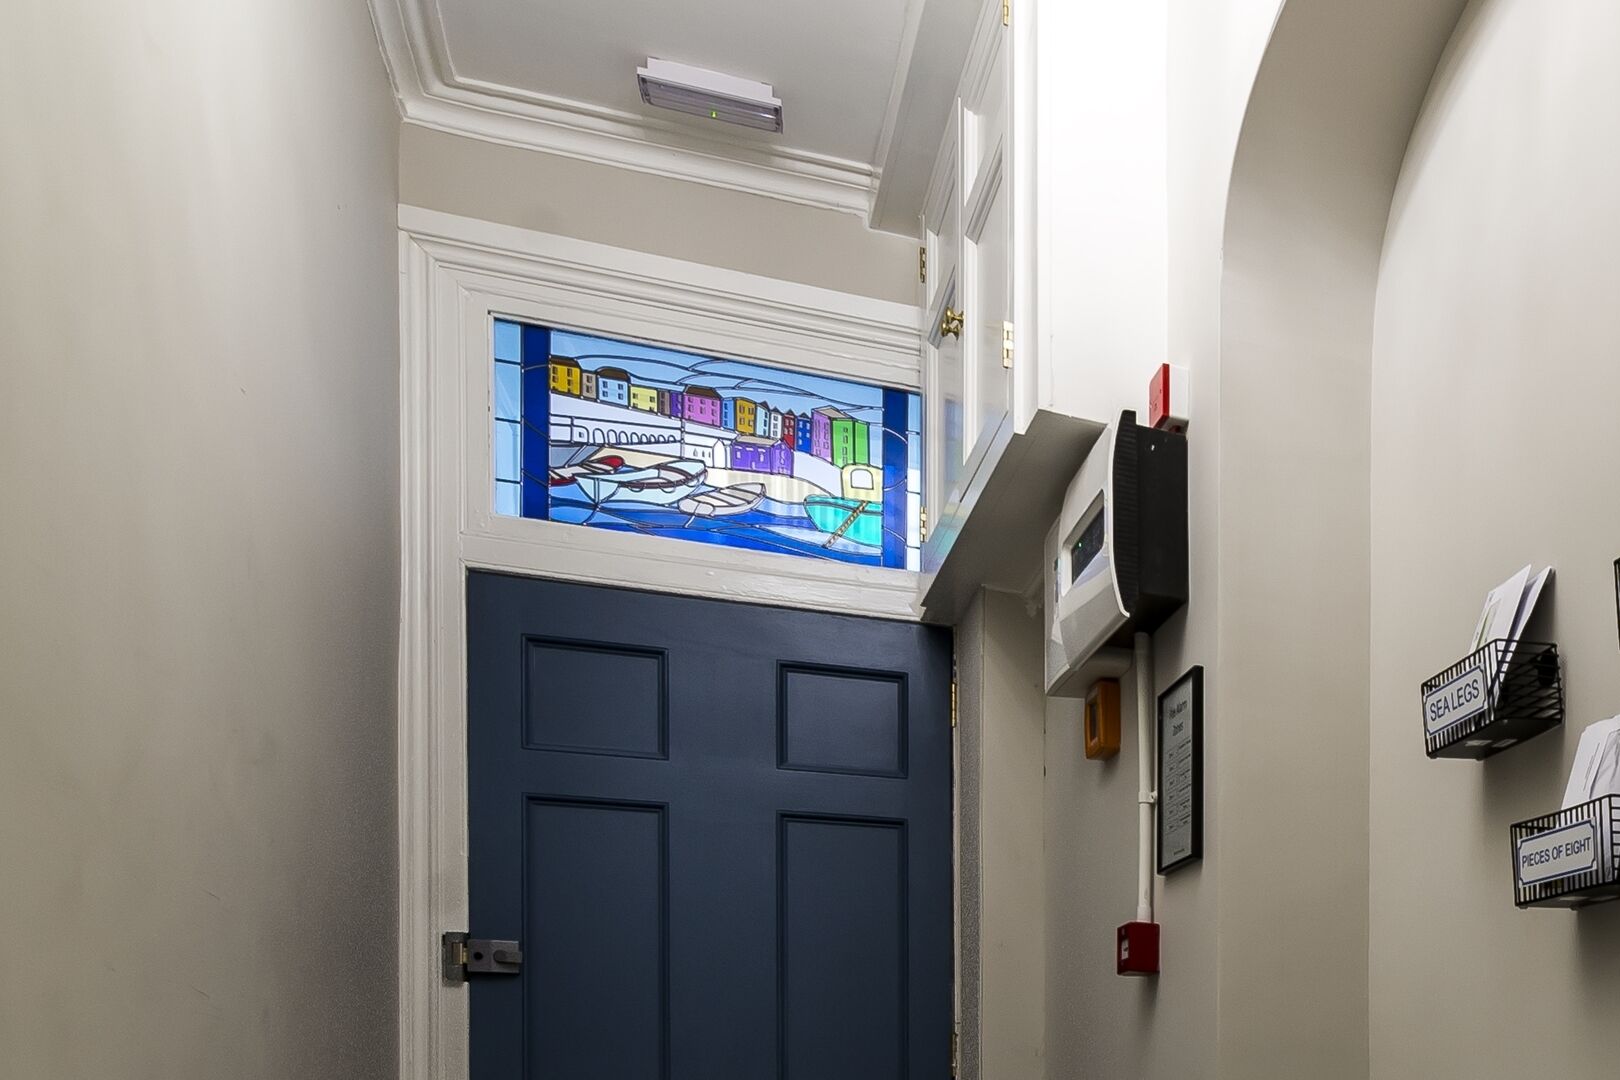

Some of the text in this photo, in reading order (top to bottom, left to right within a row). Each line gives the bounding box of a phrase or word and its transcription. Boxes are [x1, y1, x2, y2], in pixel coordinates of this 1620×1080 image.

[1430, 679, 1479, 721] SEA LEGS
[1522, 836, 1591, 868] PIECES OF EIGHT
